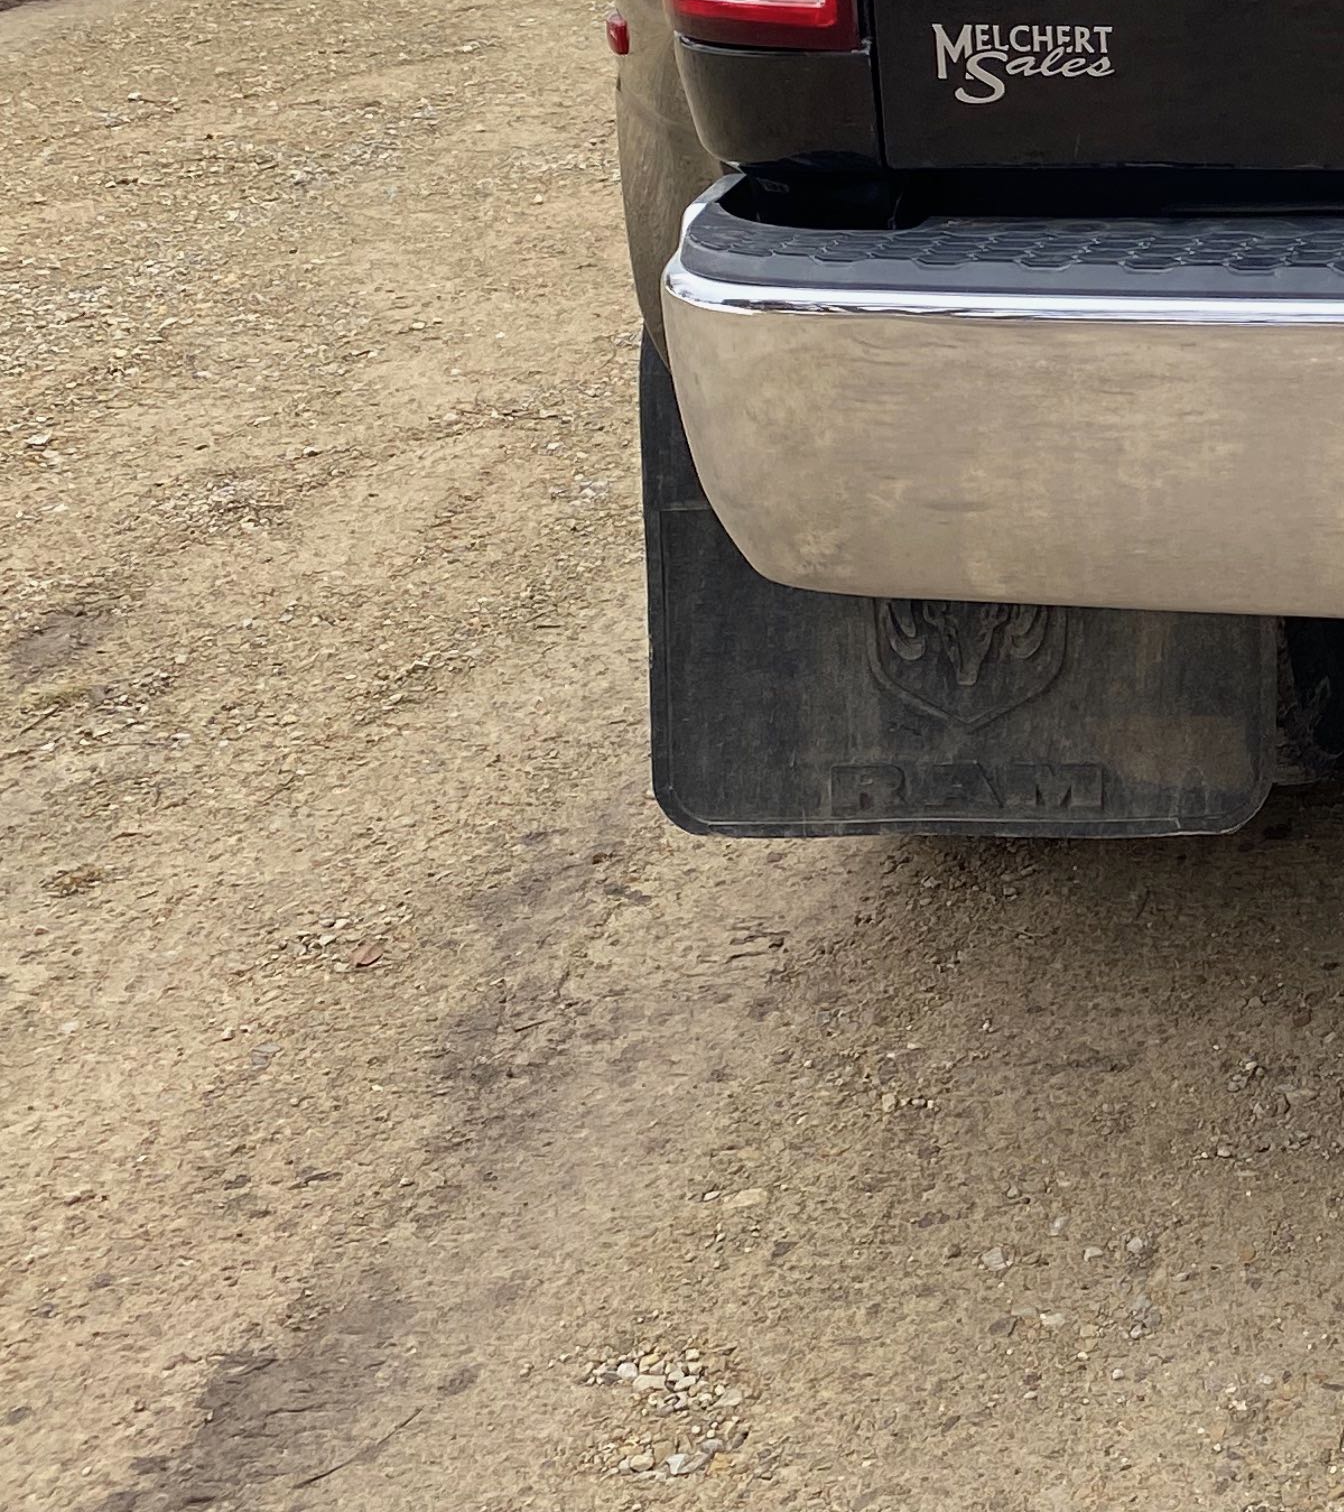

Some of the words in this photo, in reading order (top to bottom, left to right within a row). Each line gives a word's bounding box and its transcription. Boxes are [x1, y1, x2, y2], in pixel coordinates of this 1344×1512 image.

[931, 23, 1113, 80] MELCHERT
[954, 45, 1115, 104] Sales
[830, 763, 1104, 813] RAM
